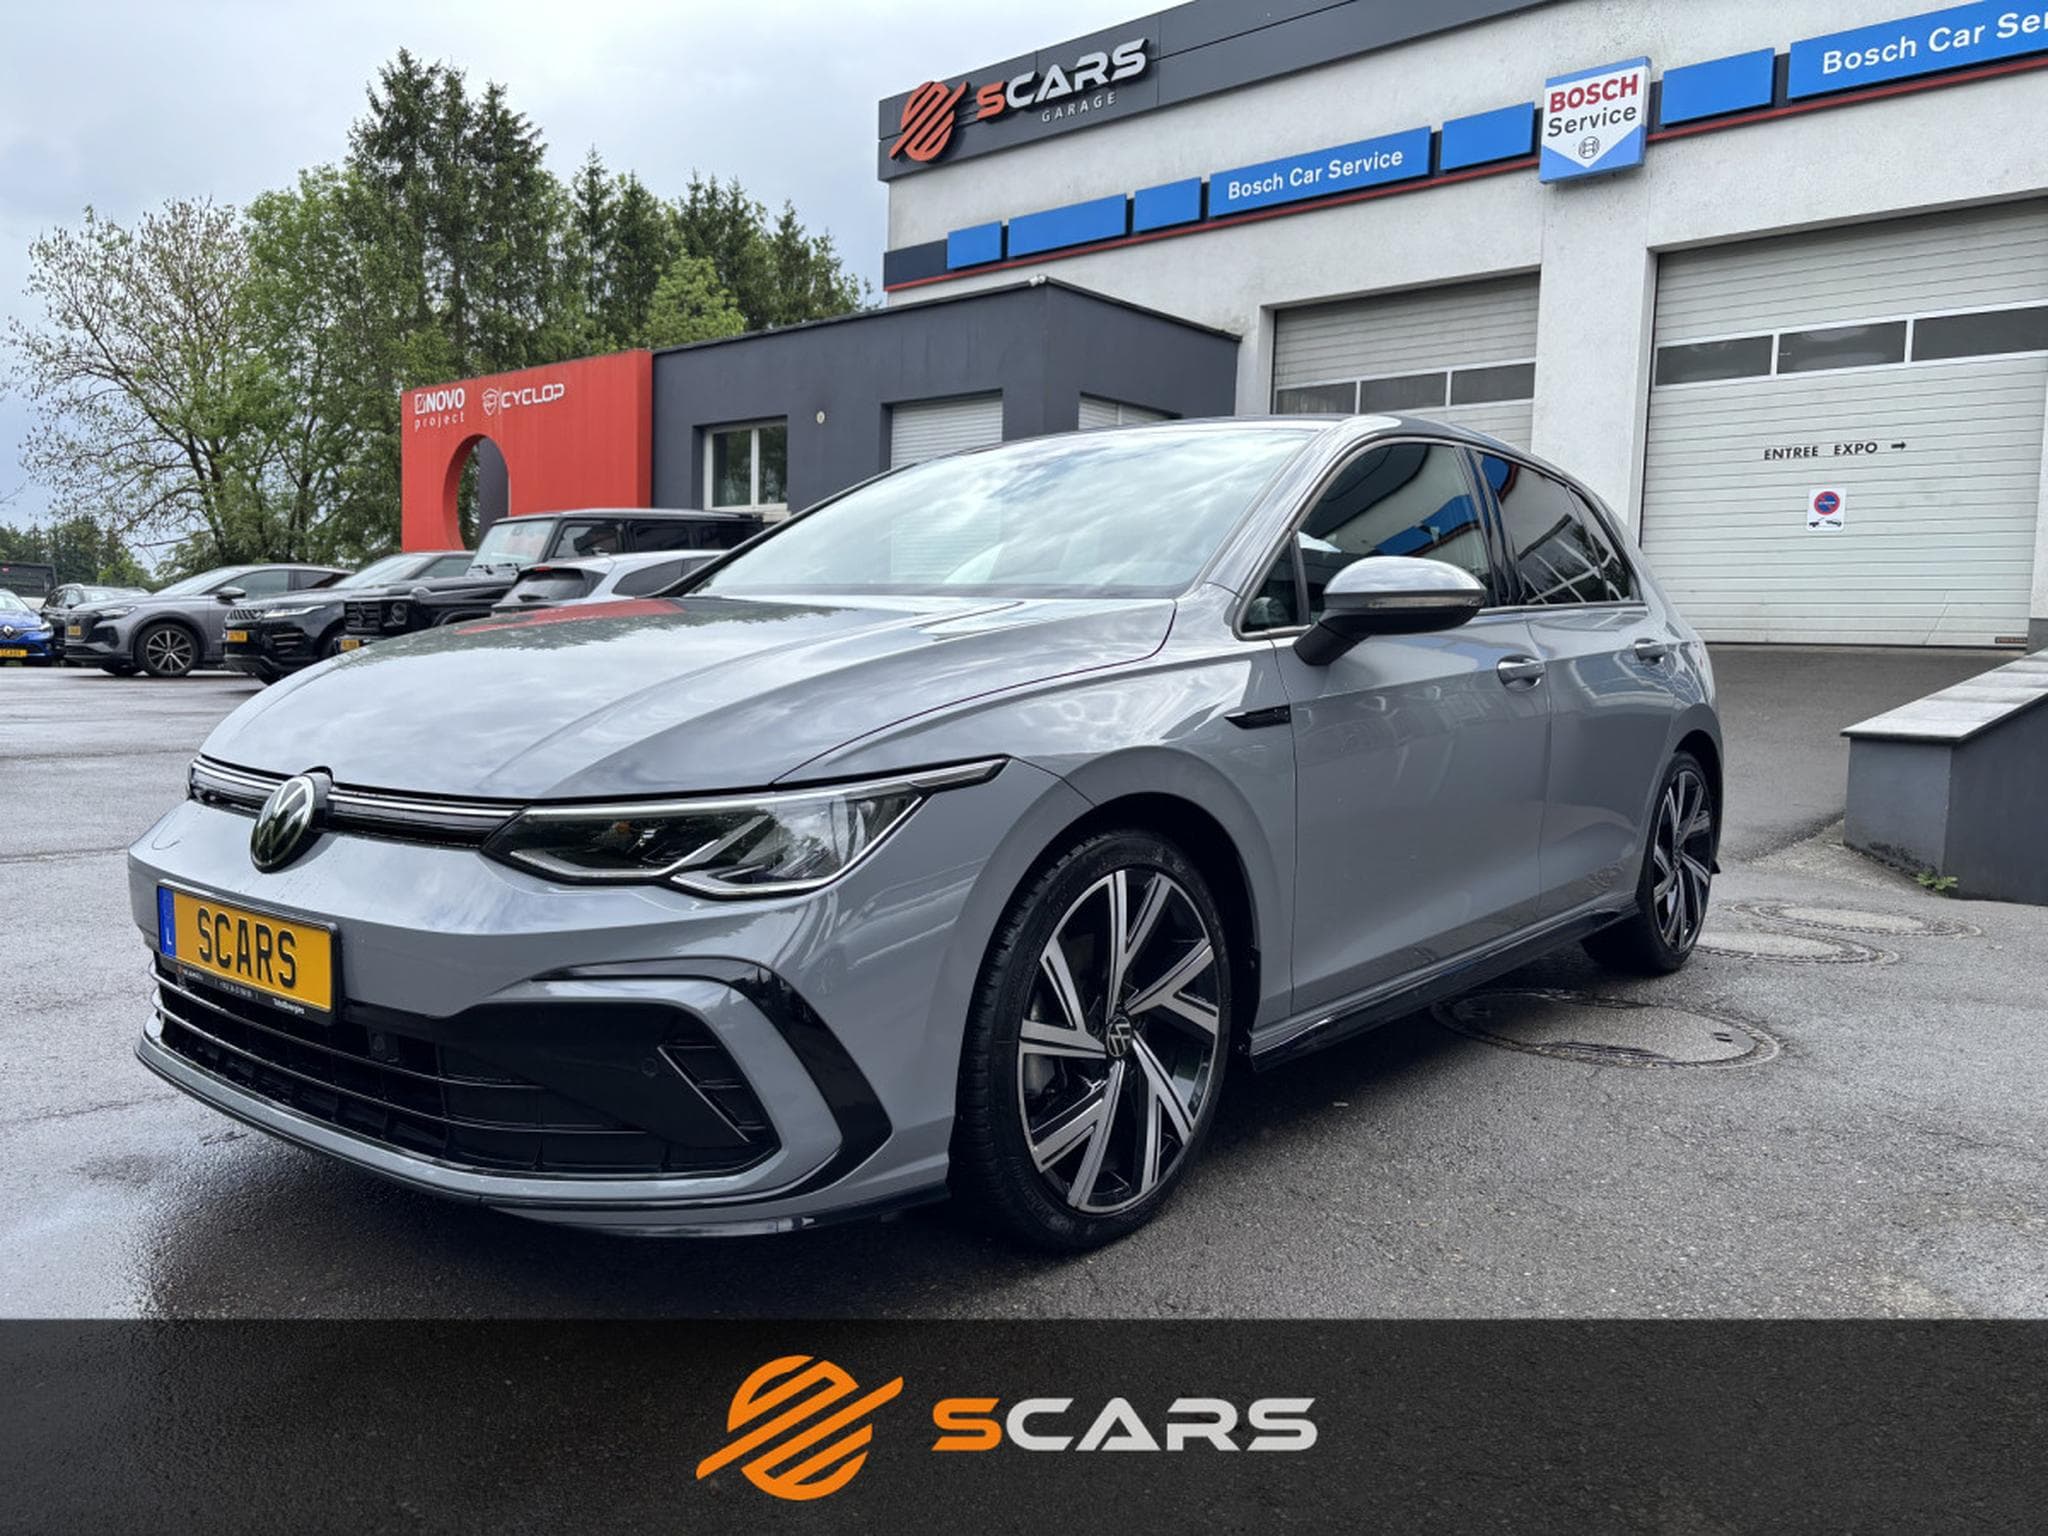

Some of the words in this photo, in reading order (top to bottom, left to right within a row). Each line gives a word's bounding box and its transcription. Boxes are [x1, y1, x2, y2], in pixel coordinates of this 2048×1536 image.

[1822, 36, 1917, 74] Bosch
[1928, 25, 1986, 52] Car
[976, 38, 1147, 121] SCARS
[1549, 73, 1639, 113] BOSCH
[1041, 91, 1117, 122] GARAGE
[1547, 106, 1637, 138] Service
[1228, 173, 1284, 200] Bosch
[1289, 166, 1323, 188] Car
[1328, 150, 1404, 179] Service
[501, 383, 565, 409] CYCLOP
[414, 411, 465, 433] project
[1763, 445, 1819, 461] ENTREE
[1833, 441, 1878, 456] EXPO
[197, 907, 297, 989] SCARS
